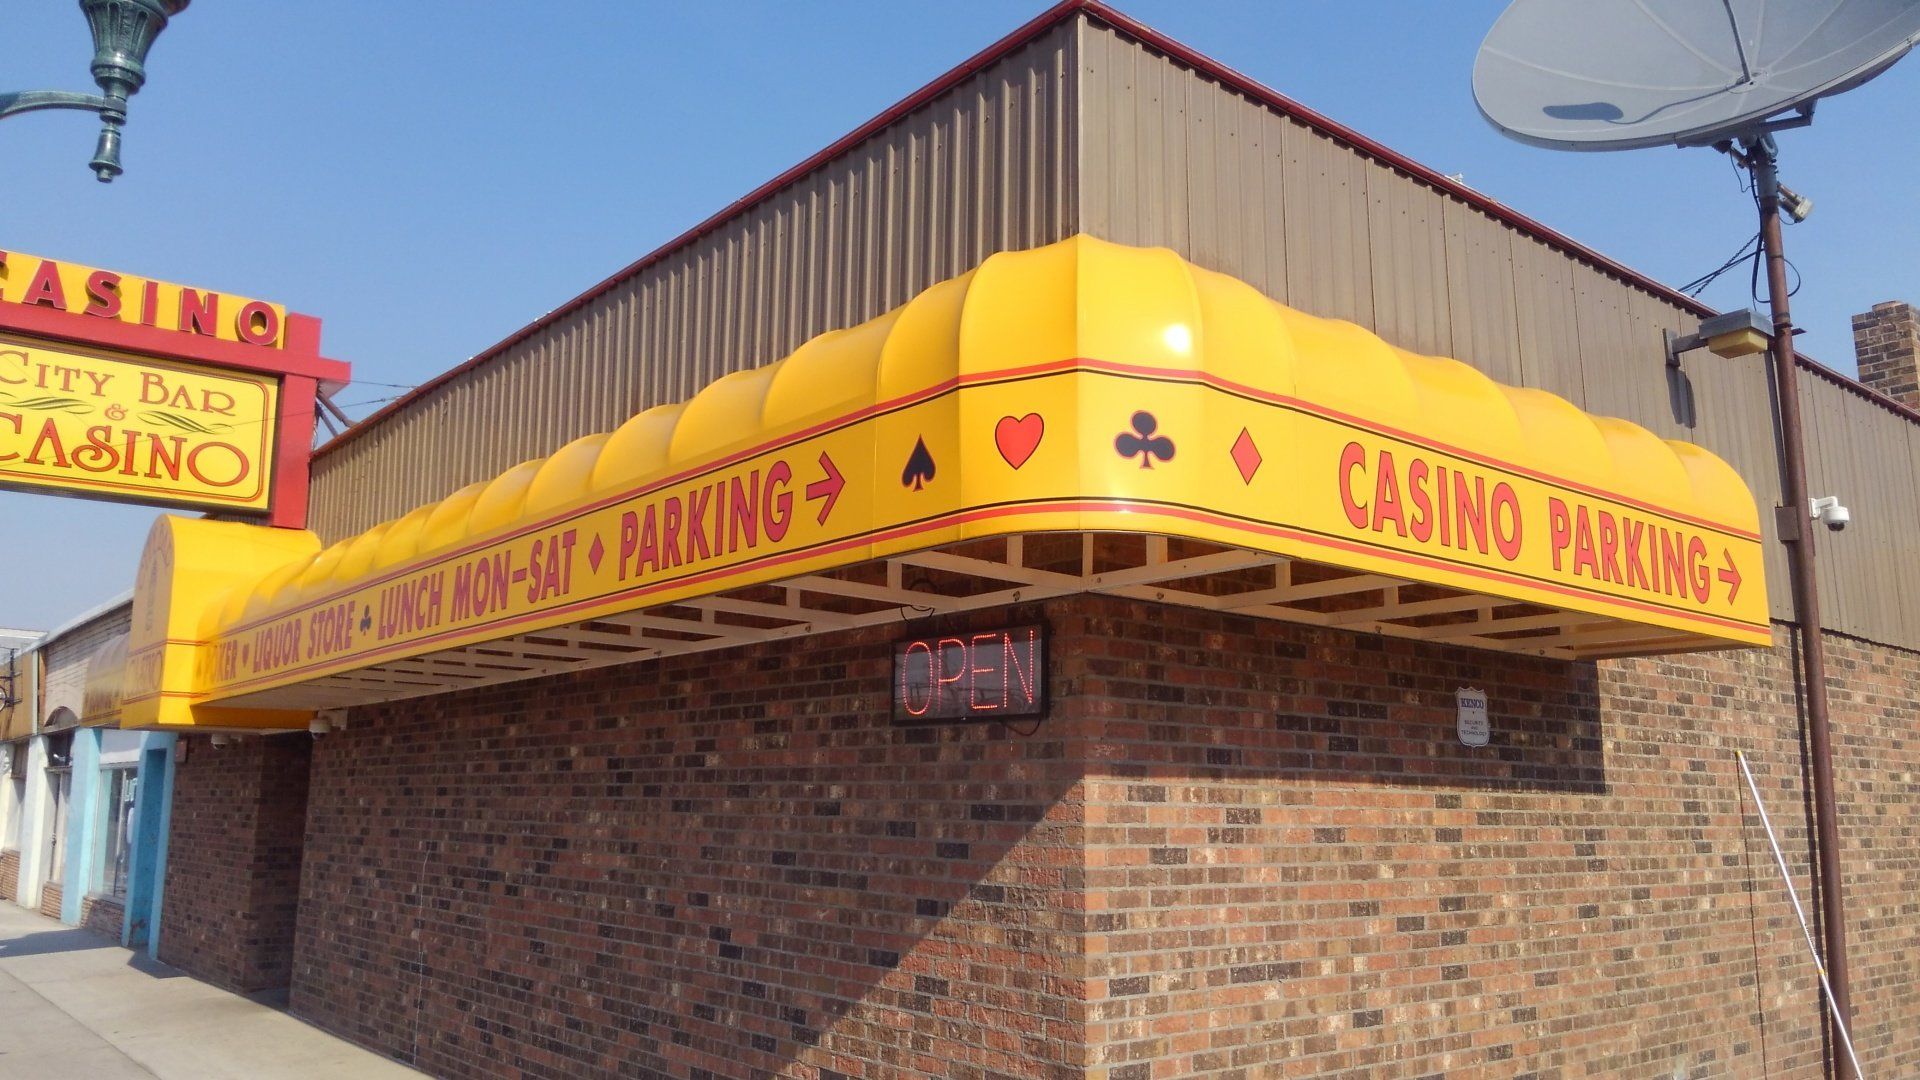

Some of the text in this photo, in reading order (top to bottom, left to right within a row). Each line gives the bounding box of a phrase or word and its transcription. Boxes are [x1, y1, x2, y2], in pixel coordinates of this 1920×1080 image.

[0, 250, 279, 345] ASINO
[104, 403, 129, 421] &
[138, 372, 236, 417] BAR
[252, 618, 302, 674] LIQUOR
[306, 600, 356, 660] STORE
[377, 570, 445, 641] LUNCH
[618, 460, 794, 582] PARKING
[1339, 441, 1711, 604] CASINO PARKING
[902, 629, 1034, 716] OPEN
